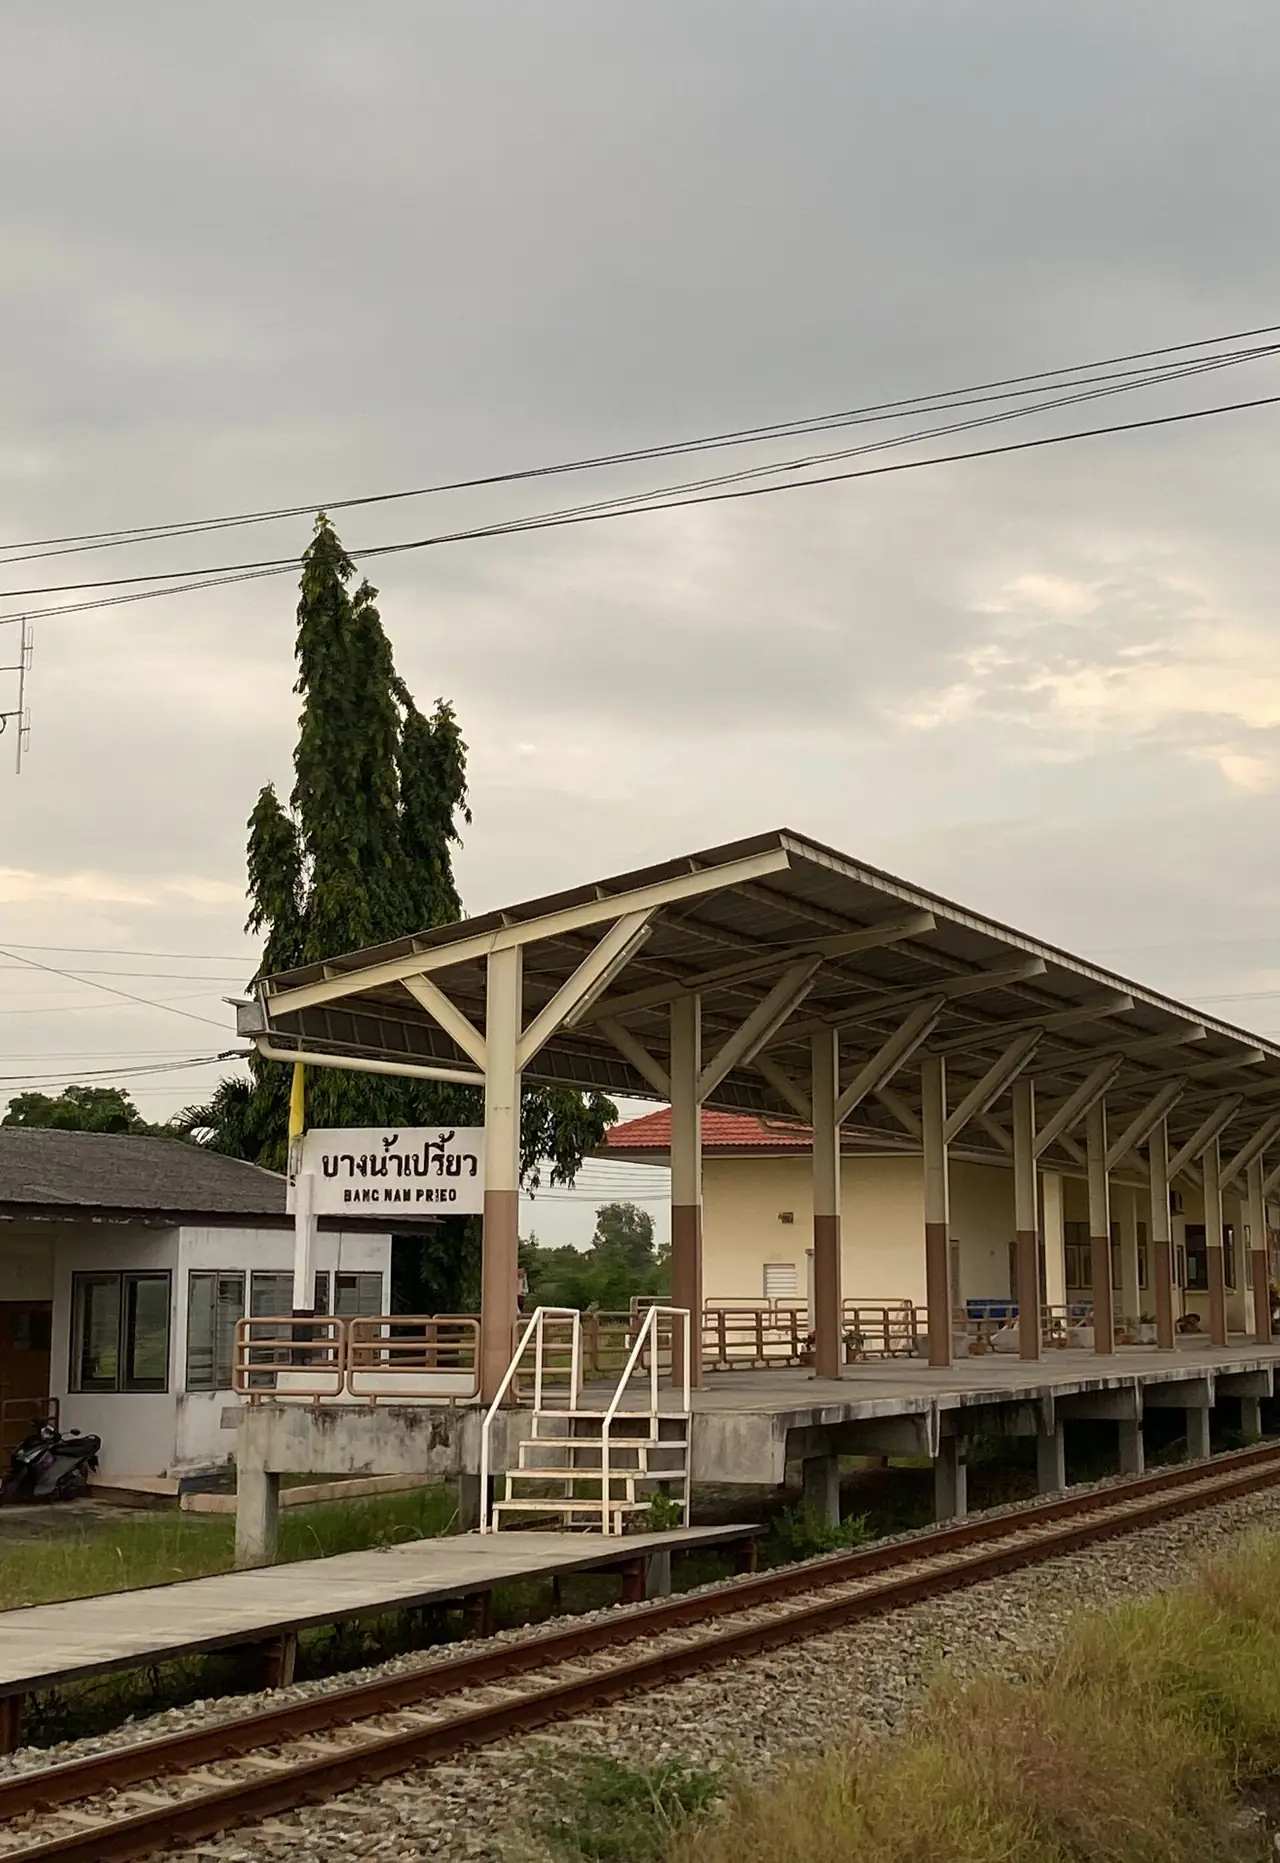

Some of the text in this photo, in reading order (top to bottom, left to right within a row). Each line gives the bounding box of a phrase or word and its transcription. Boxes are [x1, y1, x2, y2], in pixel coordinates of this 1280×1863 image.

[322, 1130, 478, 1178] บางน้ำเปรี้ยว
[343, 1188, 457, 1203] BANG NAM PRIEO
